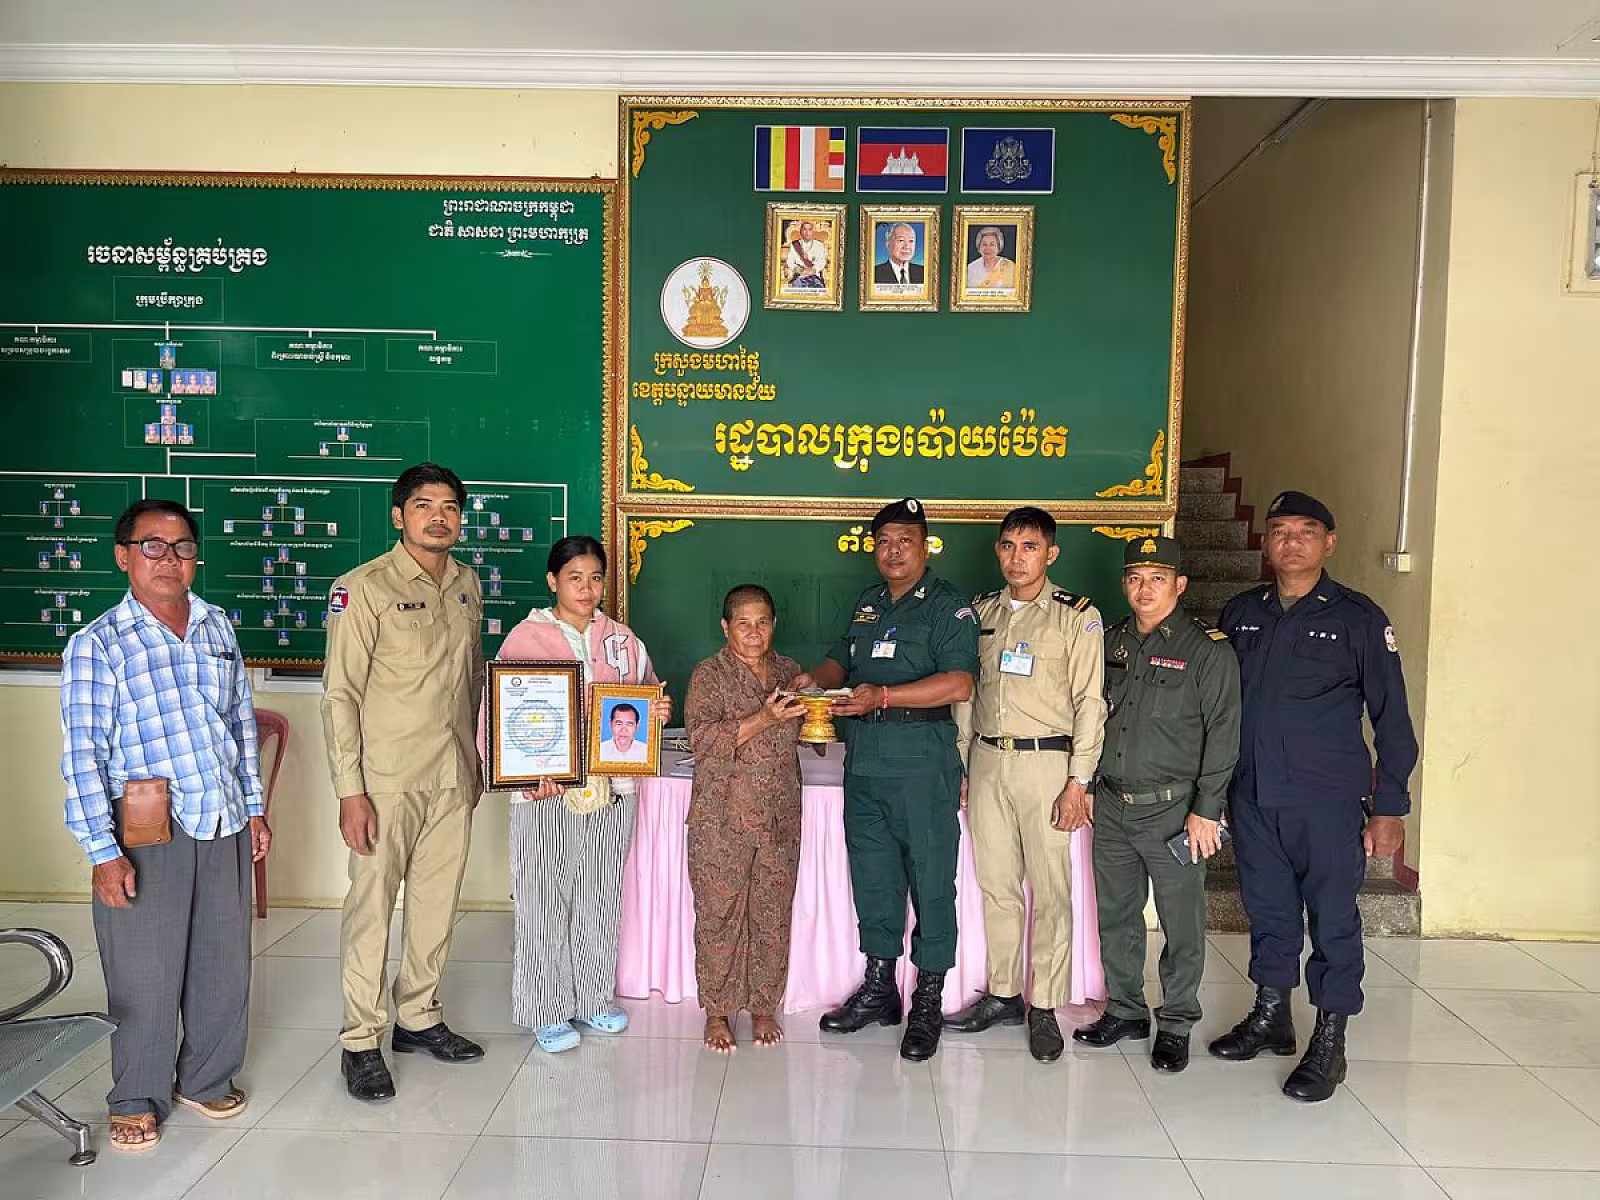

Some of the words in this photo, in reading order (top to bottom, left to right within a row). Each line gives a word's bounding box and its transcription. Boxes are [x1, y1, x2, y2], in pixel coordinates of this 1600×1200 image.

[443, 199, 574, 221] ព្រះរាជាណាចក្រកម្ពុជា
[428, 219, 454, 237] ជាតិ
[457, 226, 504, 239] សាសនា
[507, 227, 589, 244] ព្រះមហាក្សត្រ
[87, 237, 268, 272] រចនាសម្ព័ន្ធគ្រប់គ្រង
[653, 344, 750, 377] ក្រសួងមហាផ្ទៃ
[632, 376, 777, 407] ខេត្តបន្ទាយមានជ័យ
[714, 408, 1069, 472] រដ្ឋបាលក្រុងប៉ោយប៉ែត
